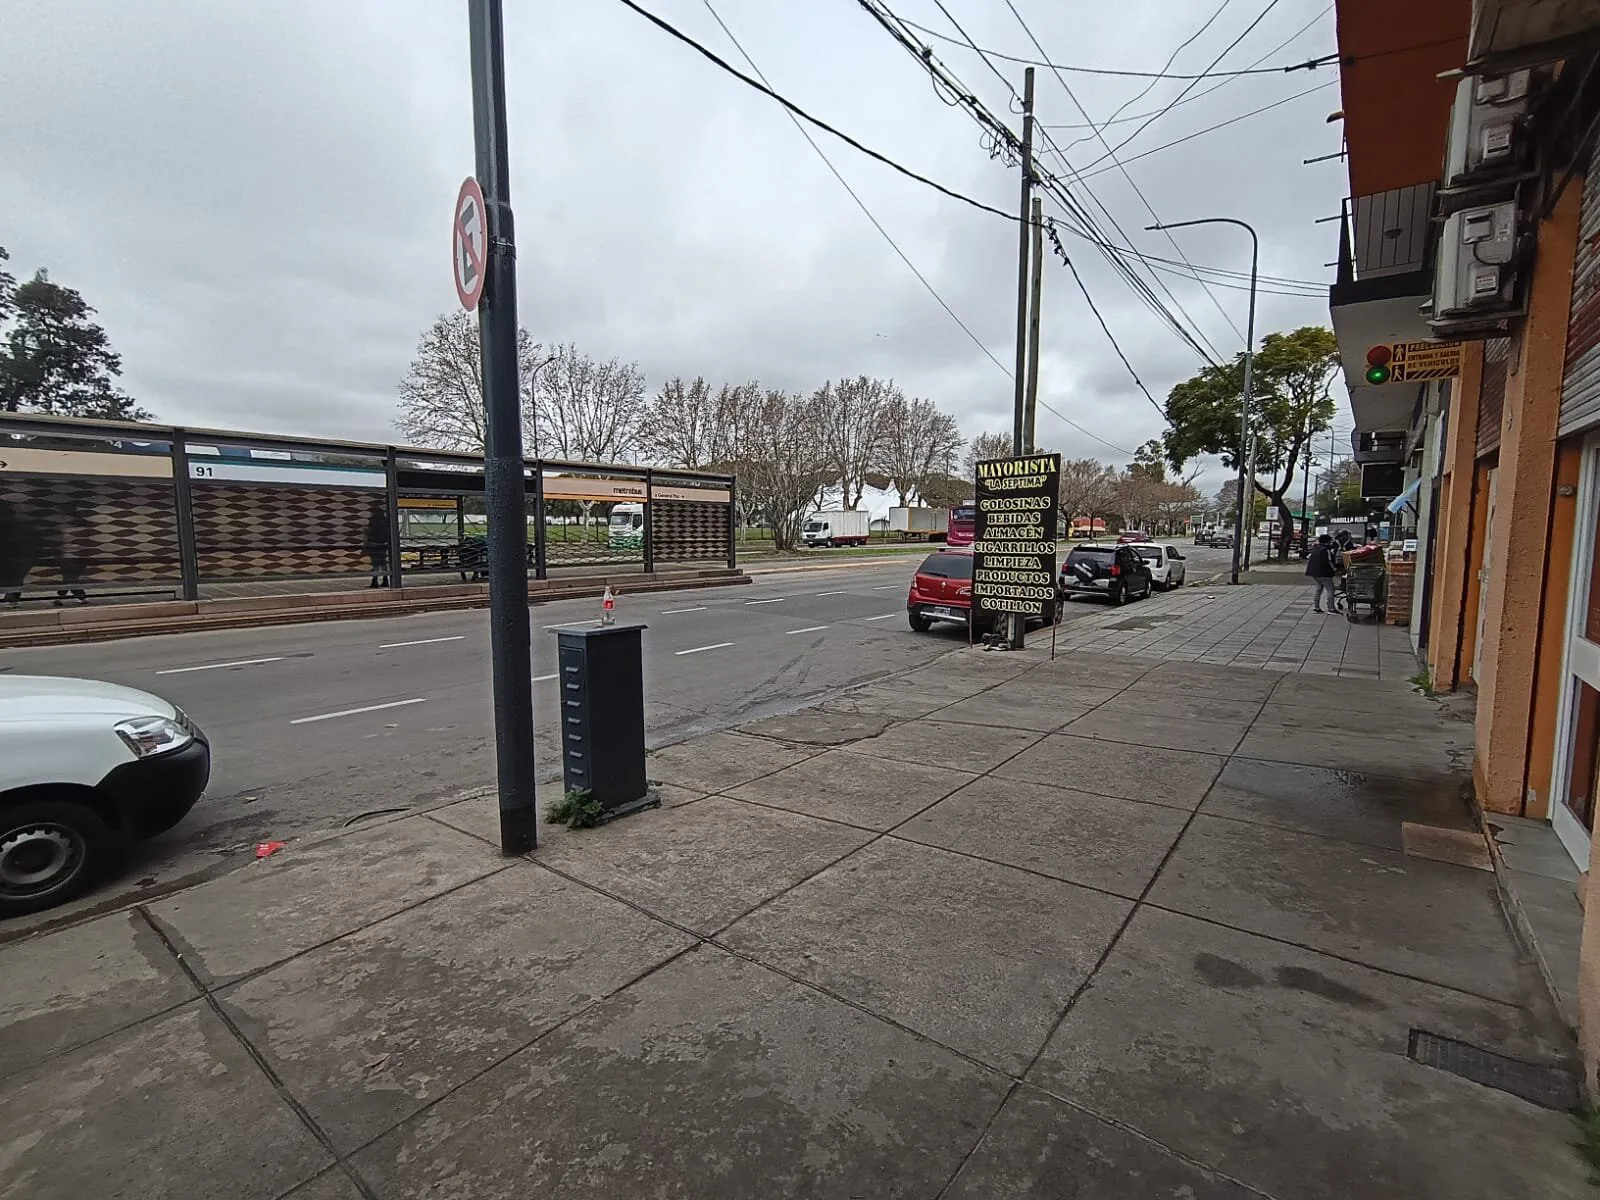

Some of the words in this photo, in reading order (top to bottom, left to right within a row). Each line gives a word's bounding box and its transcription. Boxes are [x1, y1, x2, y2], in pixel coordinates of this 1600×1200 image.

[196, 467, 213, 477] 91
[977, 457, 1056, 478] MAYORISTA
[613, 487, 642, 495] metrobus
[981, 496, 1051, 511] GOLOSINAS
[987, 512, 1041, 525] BEBIDAS
[983, 525, 1044, 539] ALMACÉN
[974, 541, 1056, 555] CIGARRILLOS
[983, 556, 1041, 569] LIMPIEZA
[975, 569, 1050, 584] PRODUCTOS
[974, 583, 1054, 600] IMPORTADOS
[981, 598, 1042, 614] COTILLON
